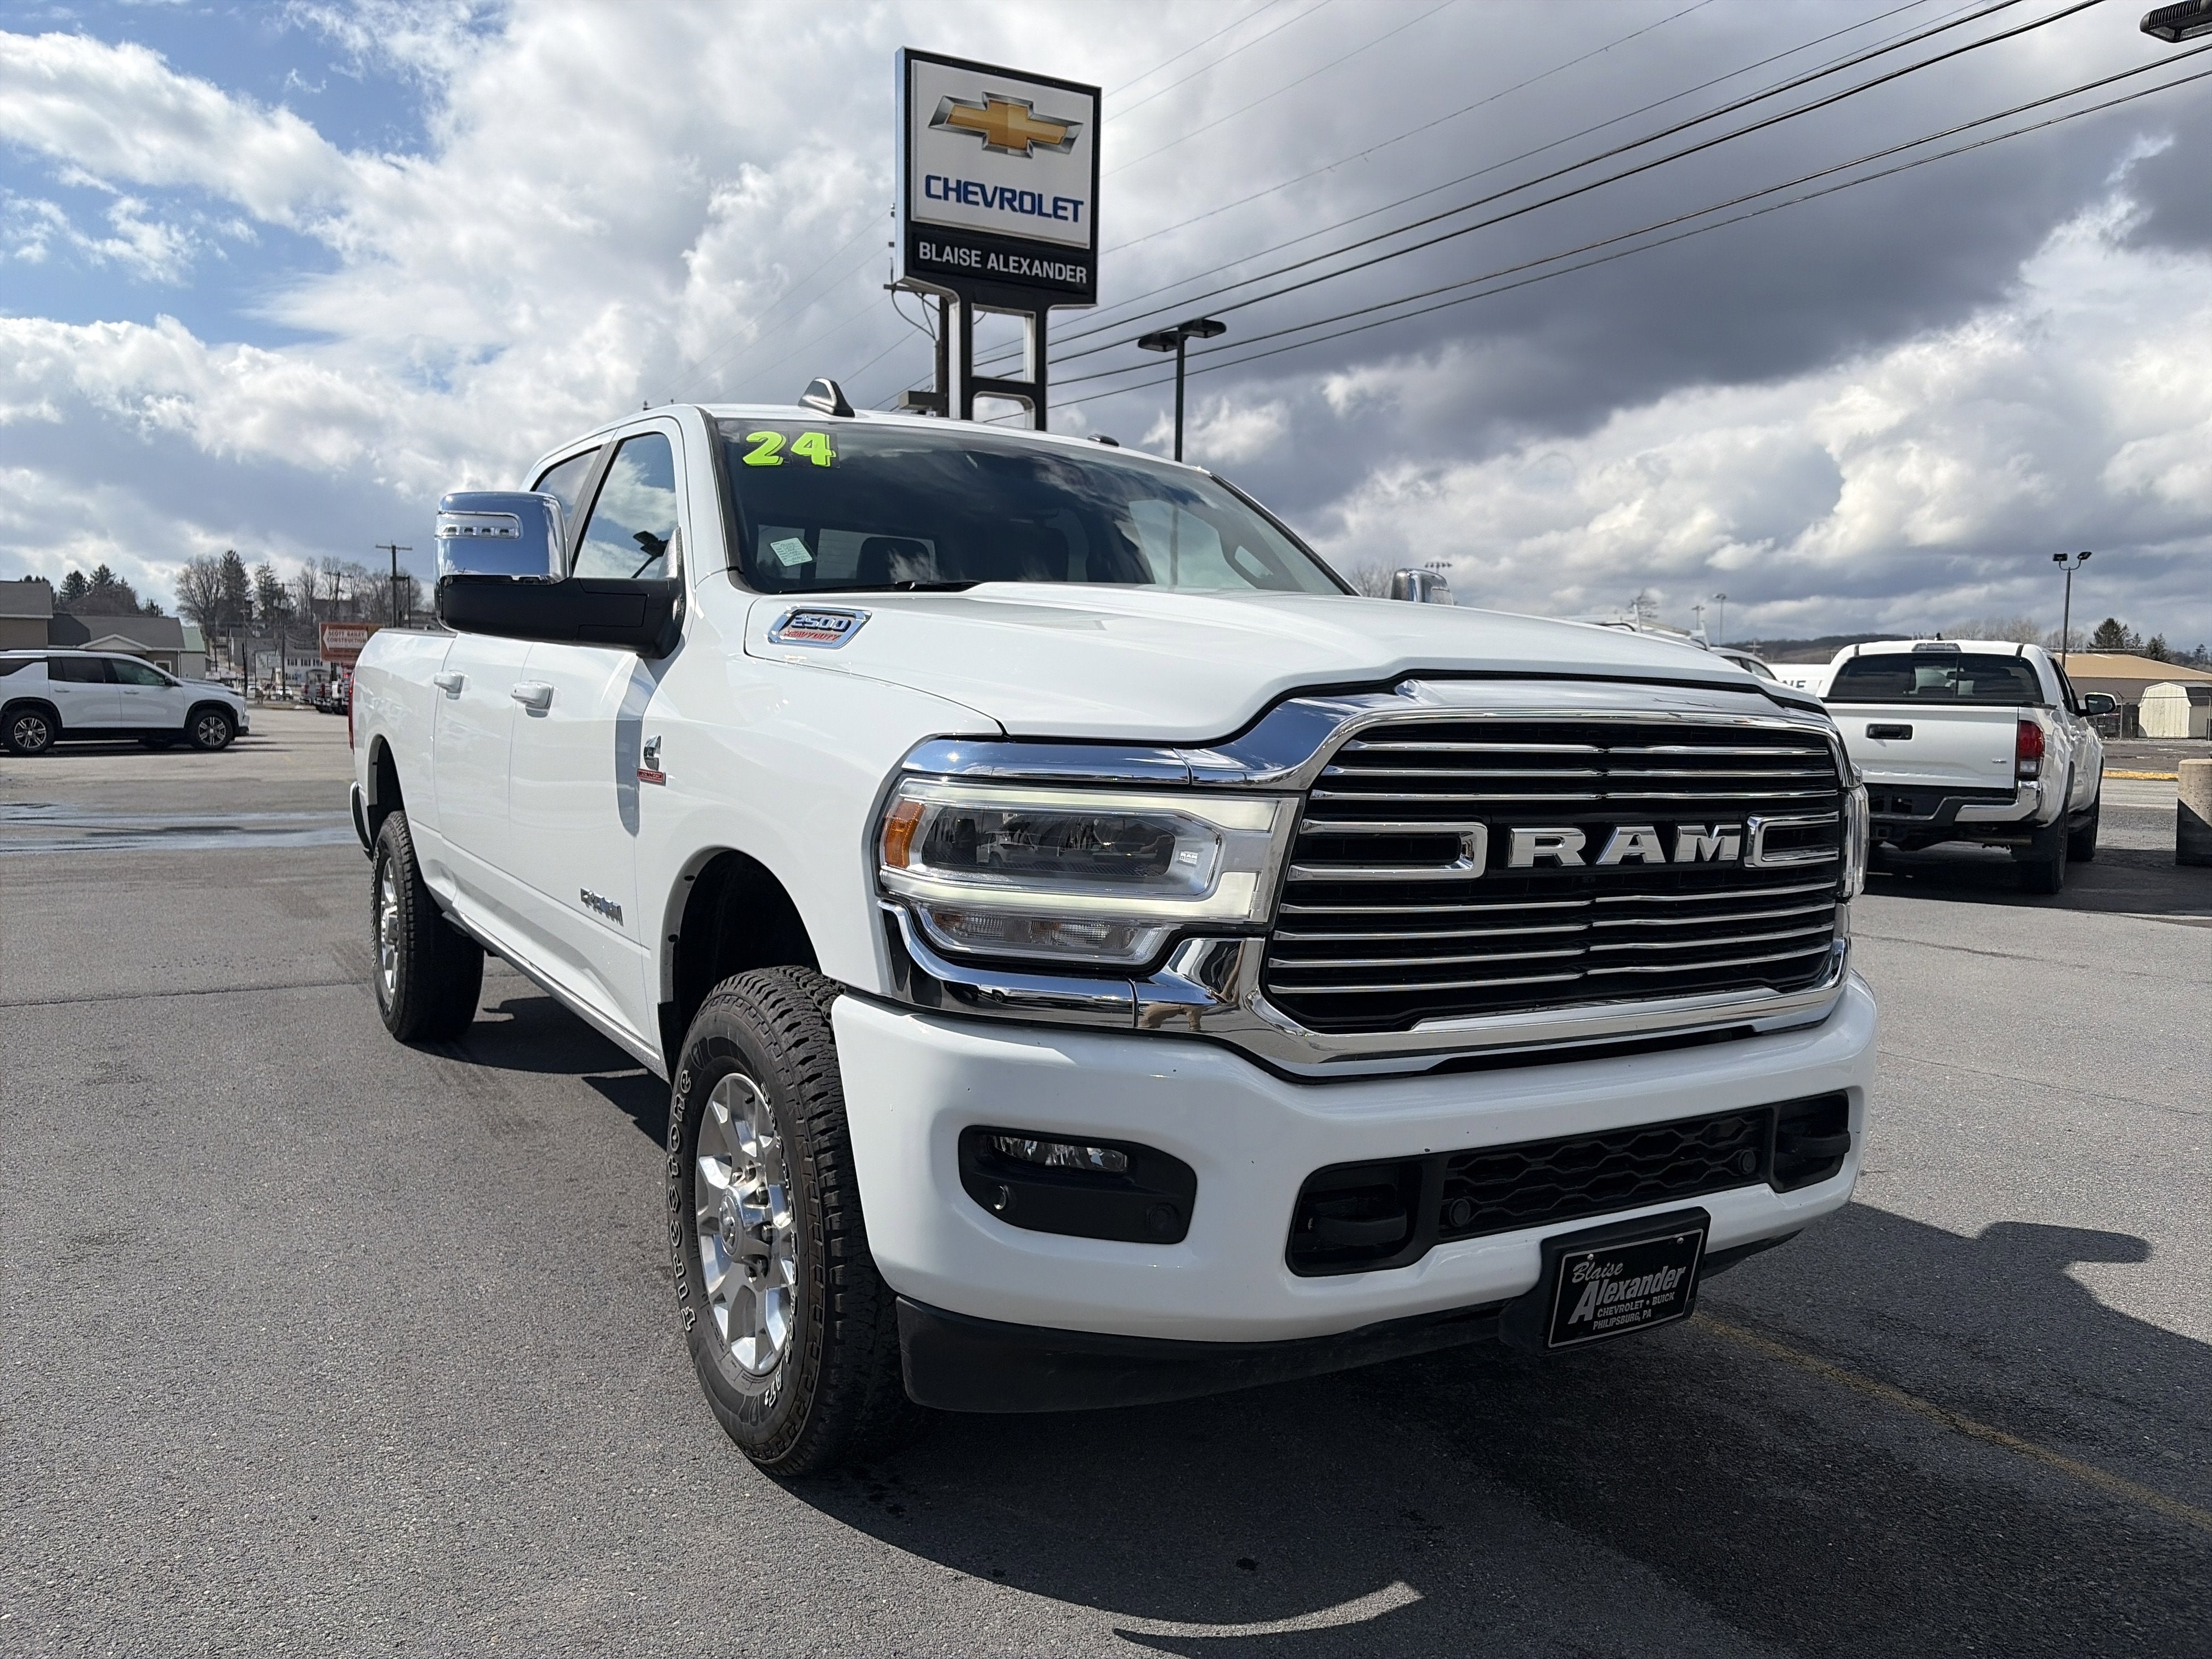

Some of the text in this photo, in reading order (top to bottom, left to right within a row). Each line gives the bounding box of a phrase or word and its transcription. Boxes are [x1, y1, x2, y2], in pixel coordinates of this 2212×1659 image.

[925, 174, 1084, 223] CHEVROLET
[919, 241, 1087, 284] BLAISE ALEXANDER
[742, 431, 837, 467] 24
[791, 615, 851, 631] 2500
[812, 633, 842, 641] DUTY
[1507, 824, 1741, 867] RAM
[1572, 1262, 1623, 1283] Blaise
[1567, 1265, 1686, 1325] Alexander
[1597, 1291, 1675, 1318] CHEVROLET BUICK
[1593, 1309, 1651, 1330] PHILIPSBURG, PA
